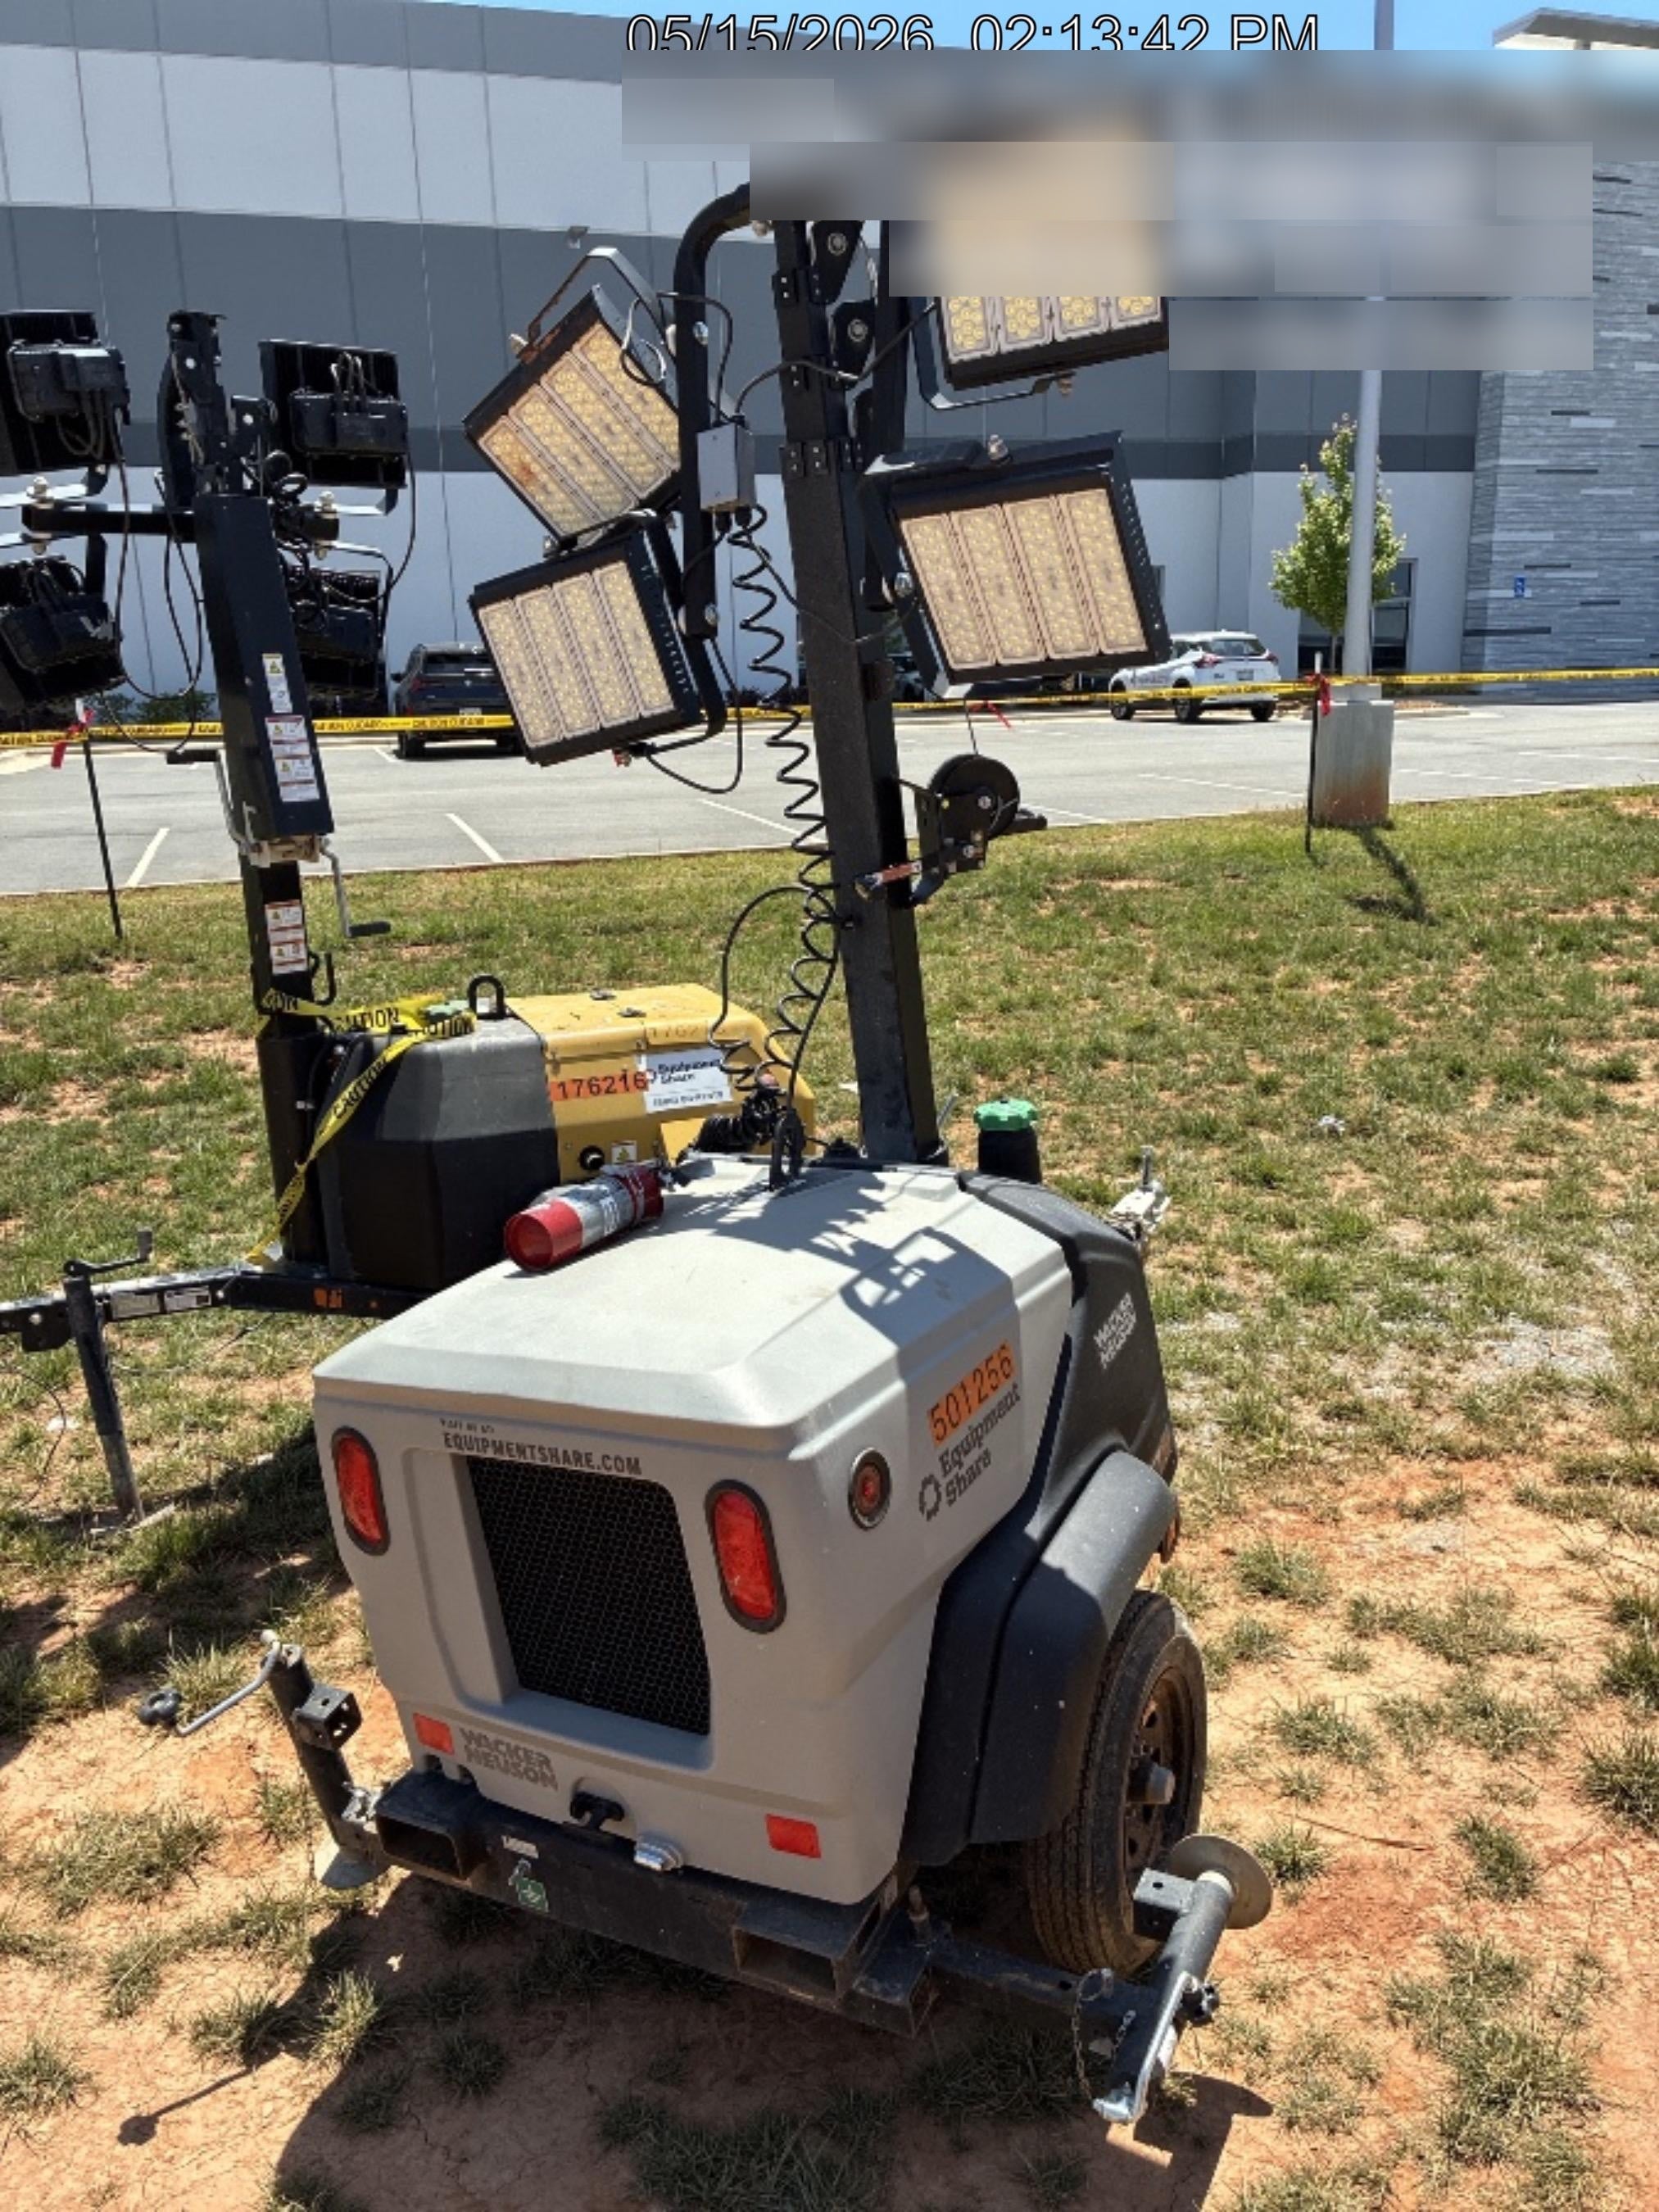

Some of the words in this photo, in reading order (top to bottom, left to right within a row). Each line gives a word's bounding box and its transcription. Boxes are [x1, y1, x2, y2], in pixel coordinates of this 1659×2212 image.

[557, 1068, 649, 1099] 176216
[929, 1342, 1013, 1443] 501256
[939, 1381, 1021, 1477] Equipment
[443, 1433, 642, 1475] EQUIPMENTSHARE.COM
[945, 1448, 991, 1507] Share
[460, 1728, 554, 1775] WACKER
[464, 1744, 559, 1792] NEUSON
